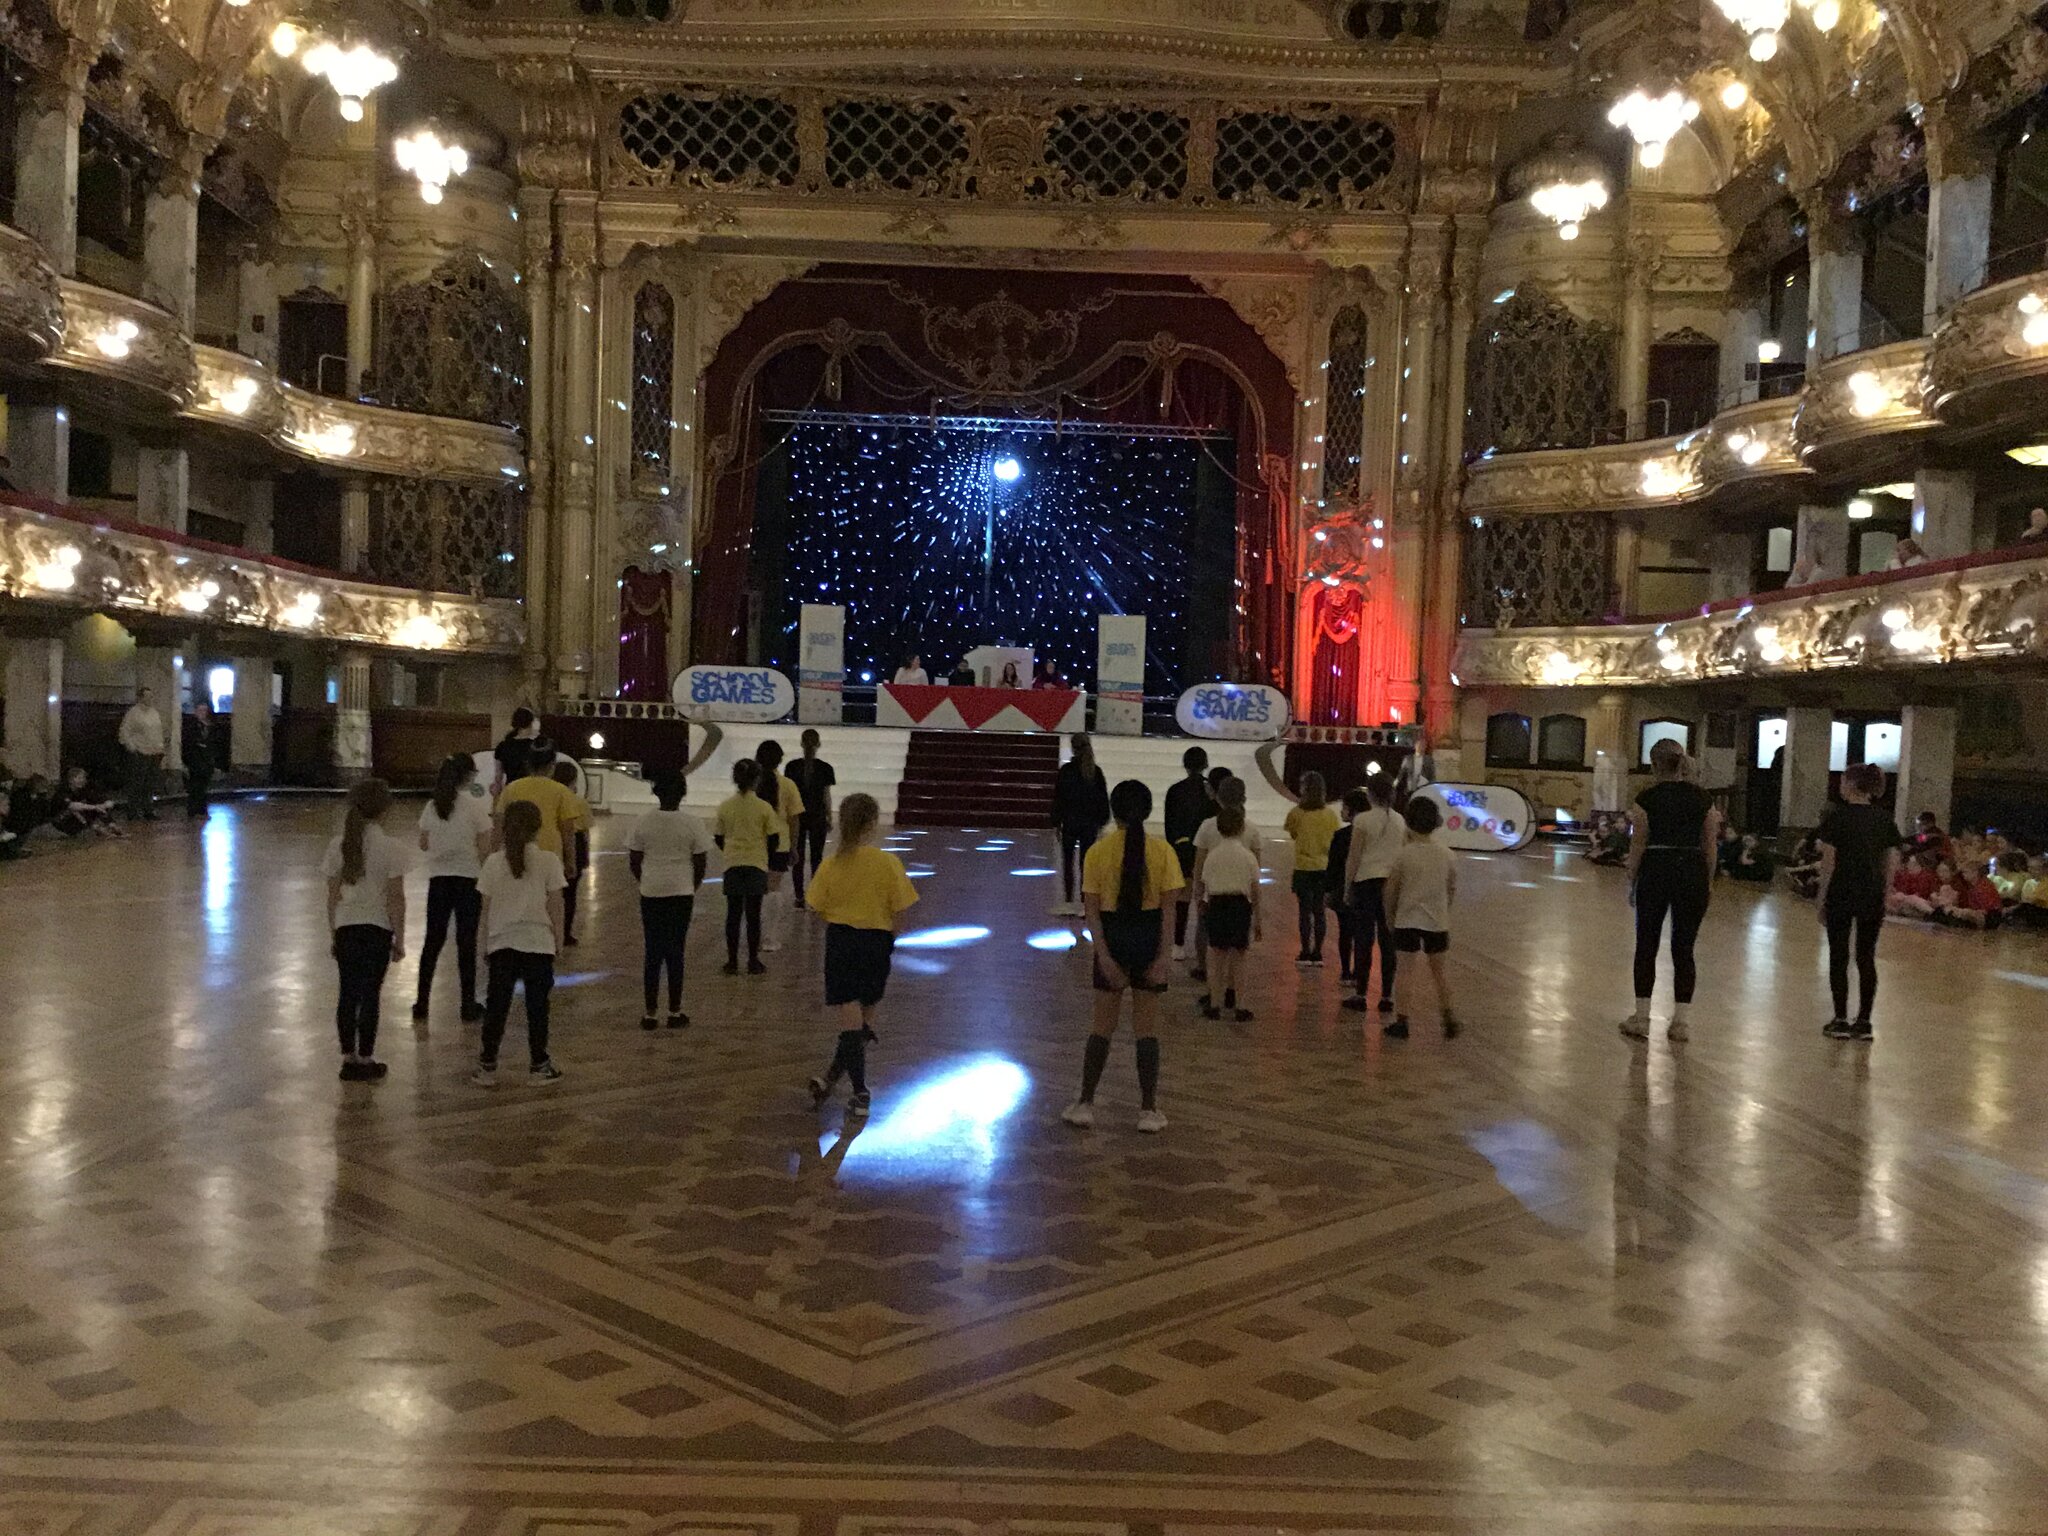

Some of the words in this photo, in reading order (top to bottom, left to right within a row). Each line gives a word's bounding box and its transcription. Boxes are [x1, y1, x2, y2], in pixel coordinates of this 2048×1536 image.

[691, 672, 777, 690] SCHOOL
[691, 684, 776, 705] GAMES
[1195, 689, 1272, 707] SCHOOL
[1193, 700, 1269, 723] GAMES
